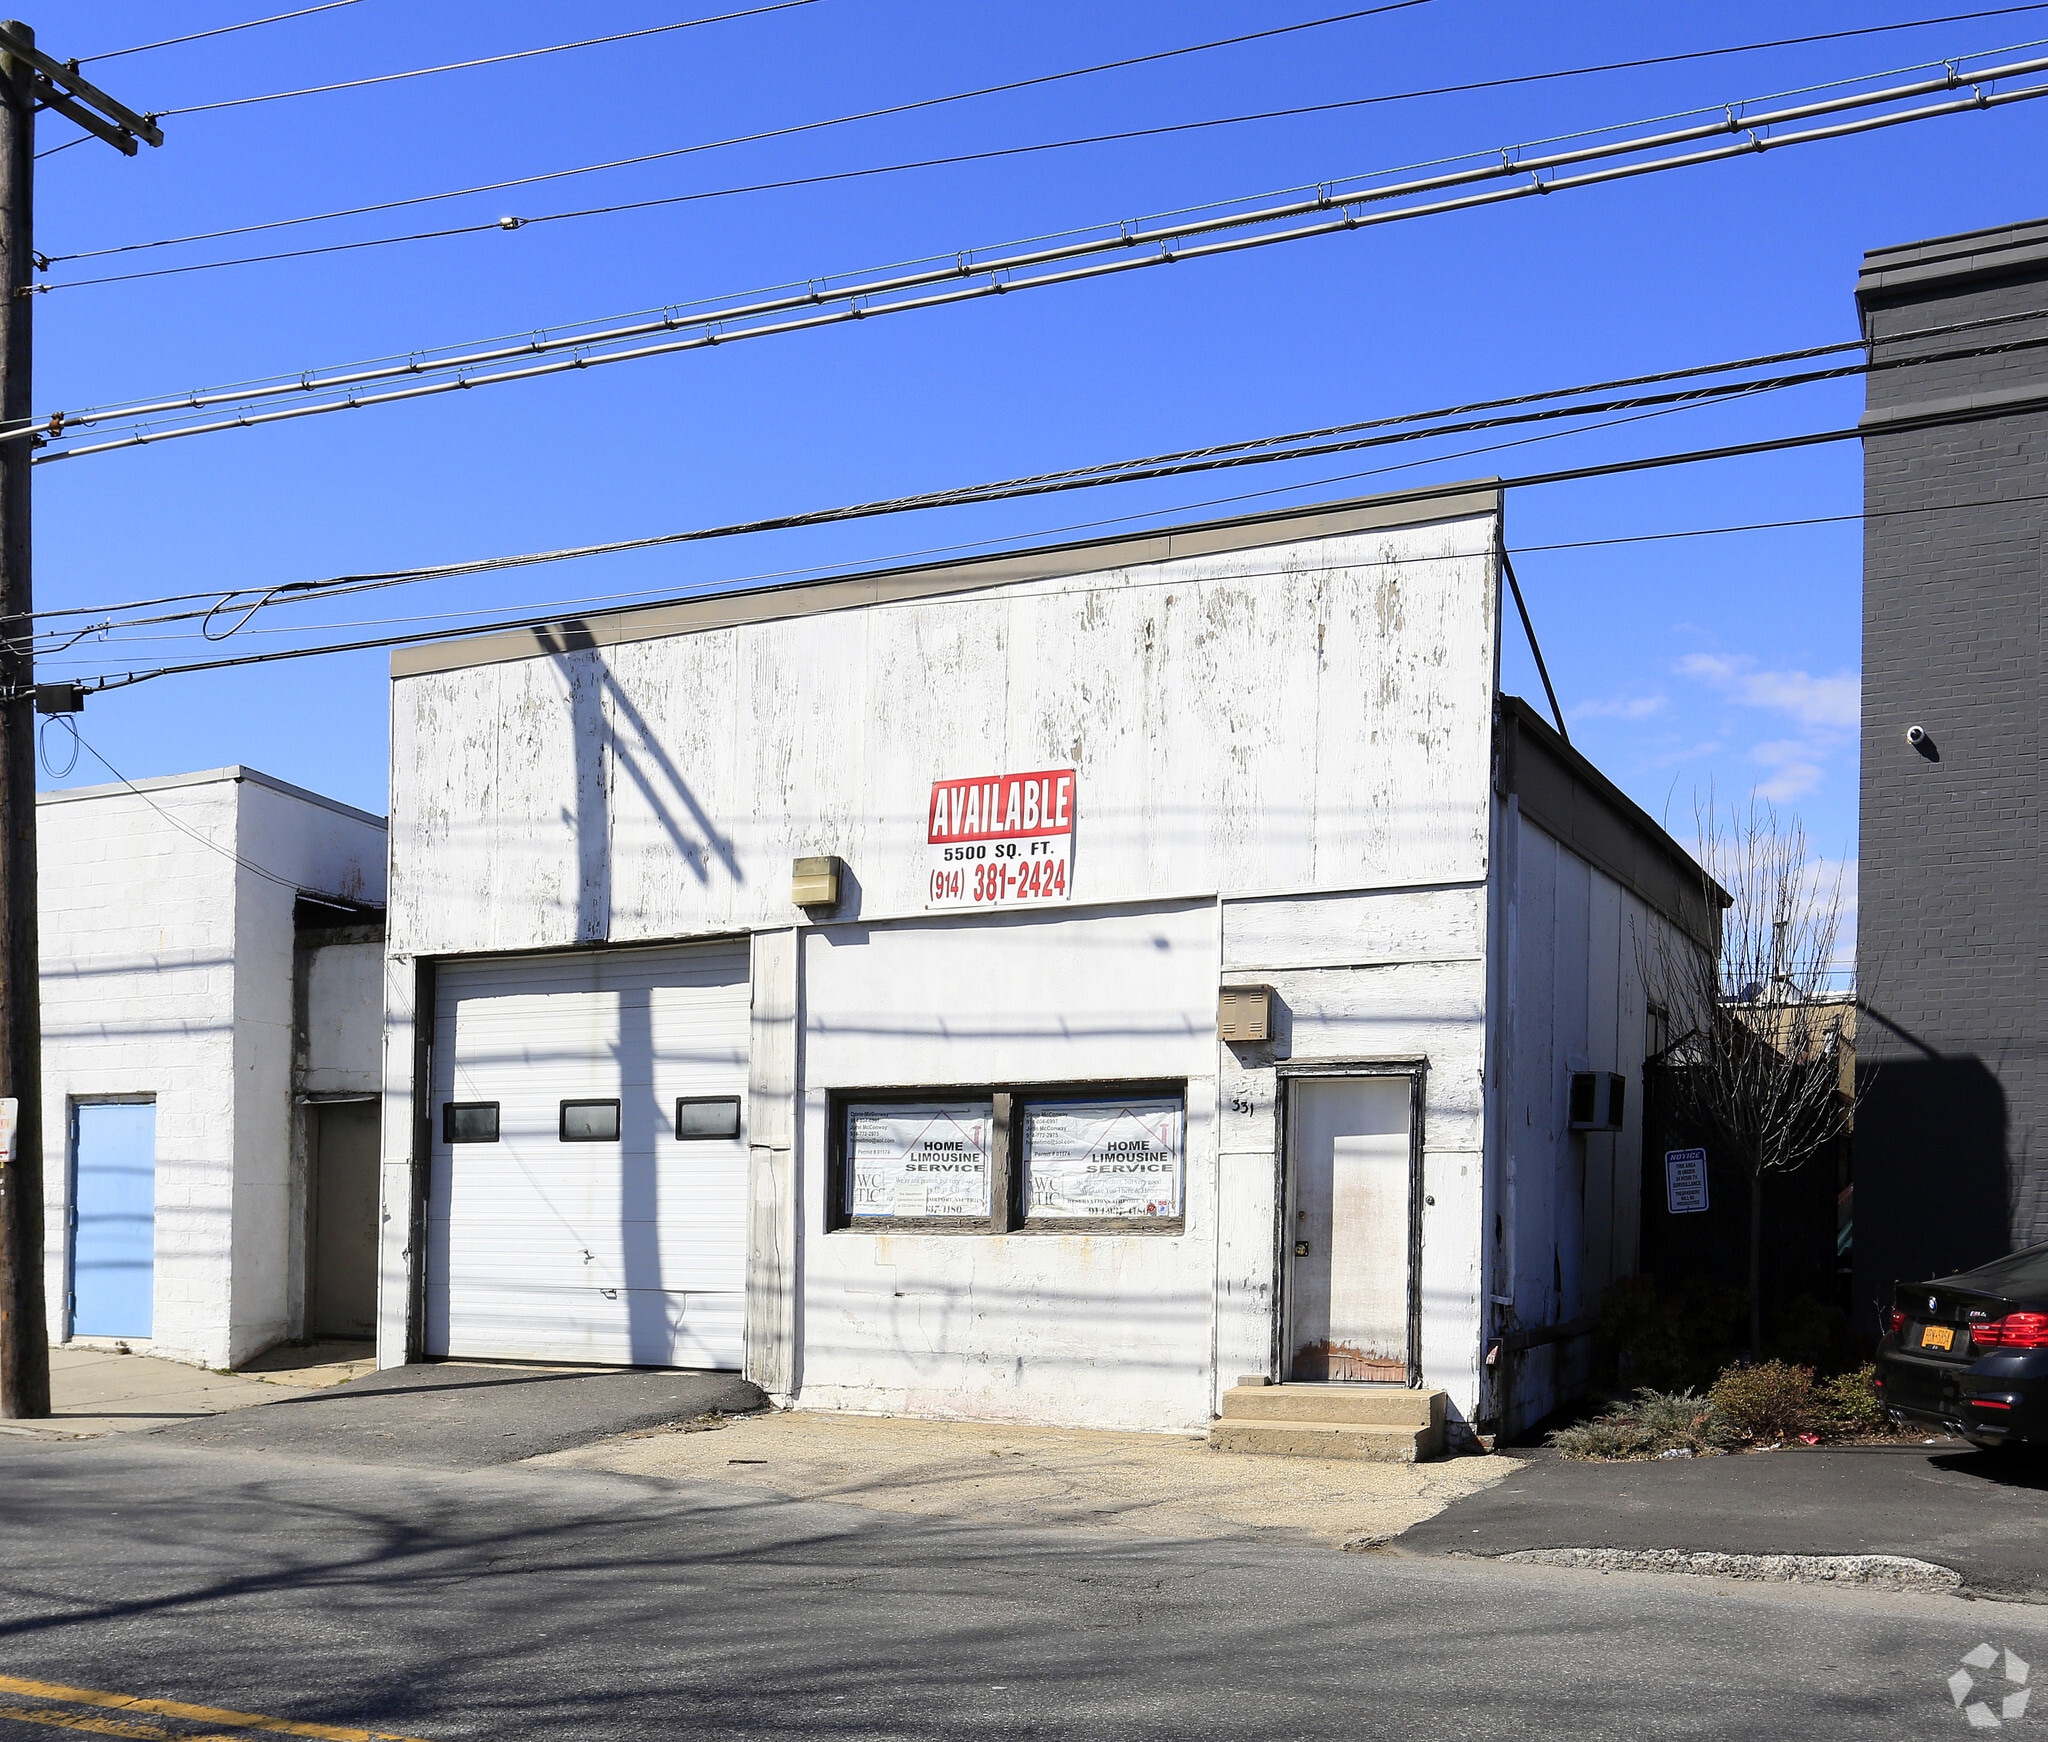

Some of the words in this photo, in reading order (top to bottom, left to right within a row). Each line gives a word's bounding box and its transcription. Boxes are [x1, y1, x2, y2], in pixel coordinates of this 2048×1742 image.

[931, 776, 1071, 837] AVAILABLE
[944, 845, 986, 861] 5500
[995, 843, 1022, 859] SQ.
[1031, 841, 1054, 855] FT.
[930, 867, 964, 902] (914)
[974, 859, 1065, 902] 381-2424
[924, 1142, 963, 1151] HOME
[1108, 1140, 1149, 1151] HOME
[910, 1152, 980, 1162] LIMOUSINE
[1092, 1152, 1168, 1163] LIMOUSINE
[1670, 1152, 1701, 1161] NOTICE
[906, 1164, 984, 1172] SERVICE
[1086, 1164, 1173, 1173] SERVICE
[857, 1174, 881, 1188] WC
[1034, 1177, 1060, 1191] WC
